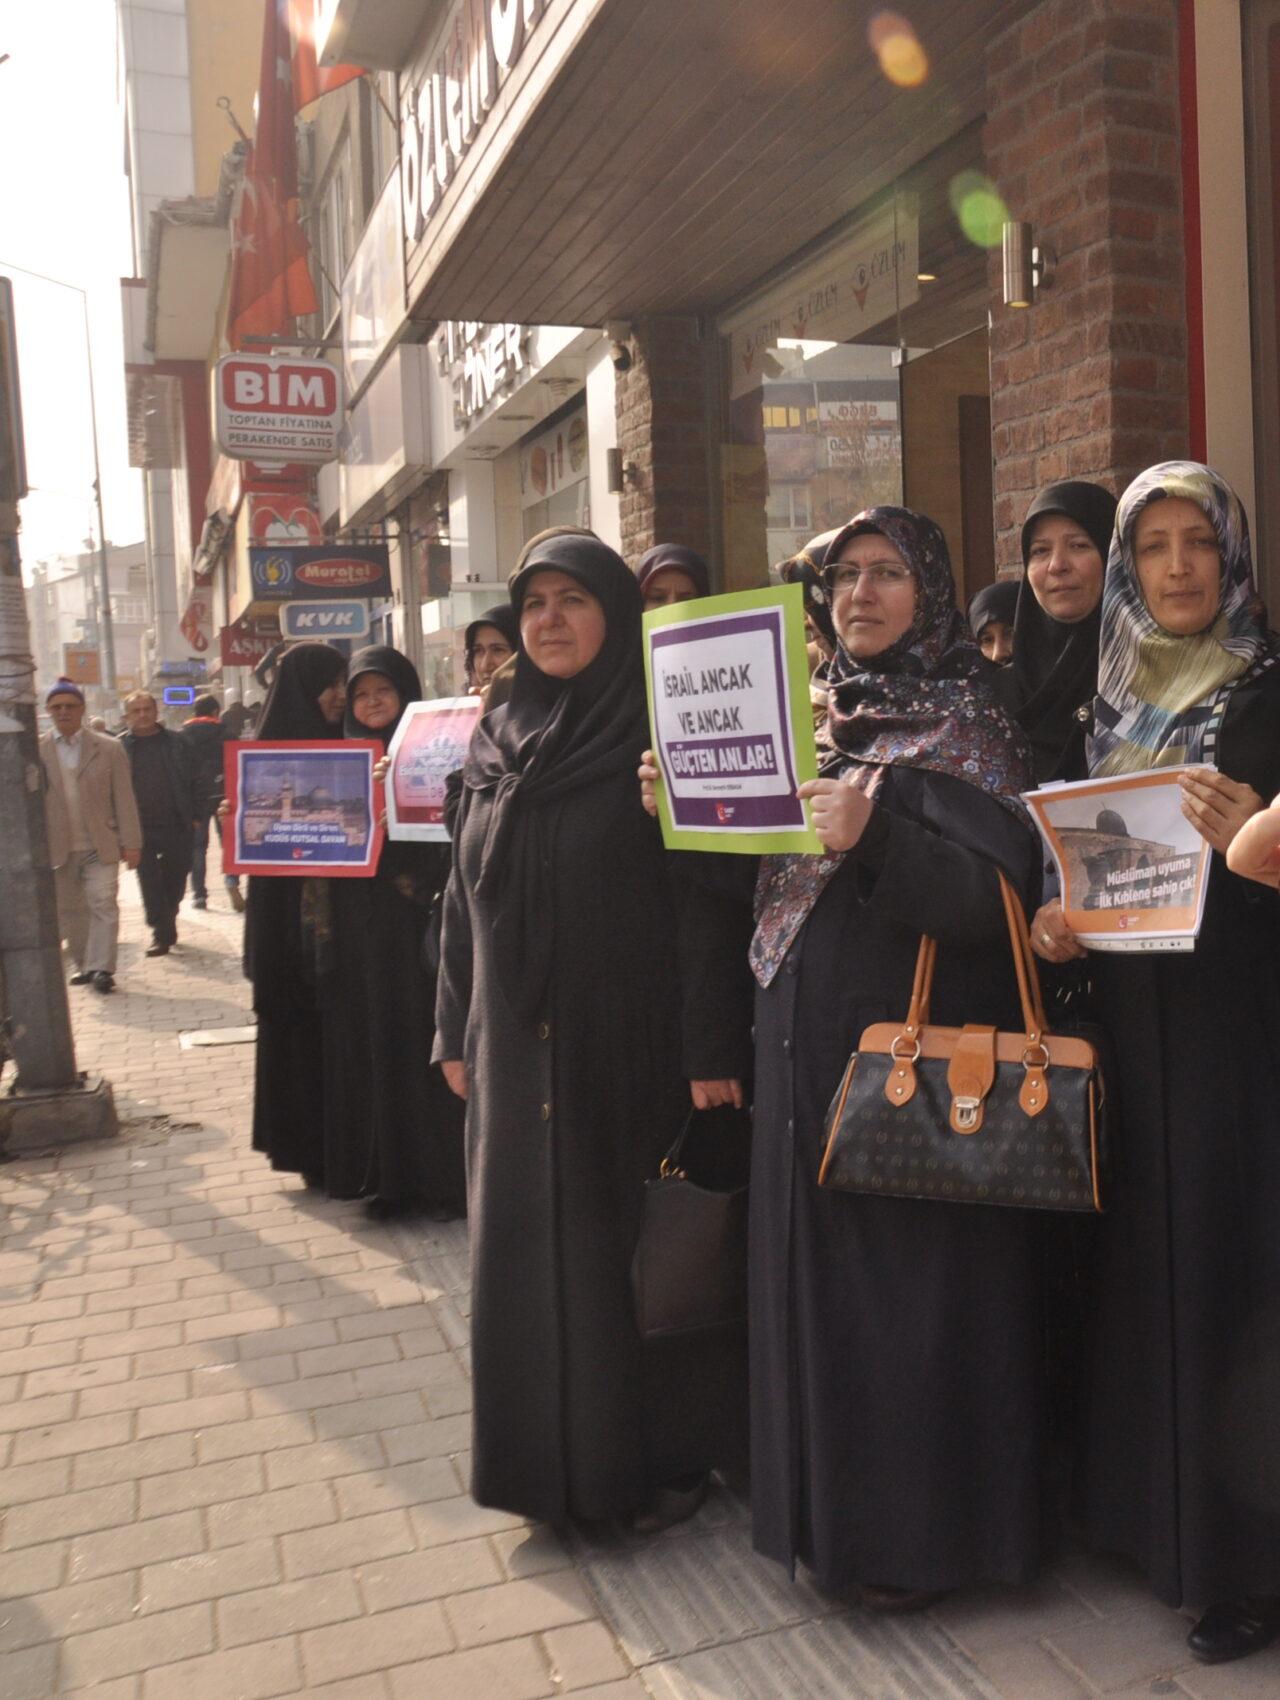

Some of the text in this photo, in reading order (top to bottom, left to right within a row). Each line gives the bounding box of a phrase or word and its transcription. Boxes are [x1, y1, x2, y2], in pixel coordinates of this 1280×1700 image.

[228, 414, 276, 427] TOPTAN
[228, 433, 297, 446] PERAKENDE
[305, 565, 370, 581] Muratel
[296, 611, 355, 628] KVK
[663, 663, 753, 698] İSRAİL ANCAK
[678, 706, 744, 736] VE ANCAK
[671, 744, 774, 776] GÜÇTEN ANLAR!
[1107, 857, 1191, 887] Müslüman uyuma
[1114, 887, 1151, 906] Kıblene
[1152, 880, 1178, 899] sahip
[1179, 874, 1197, 895] çık!
